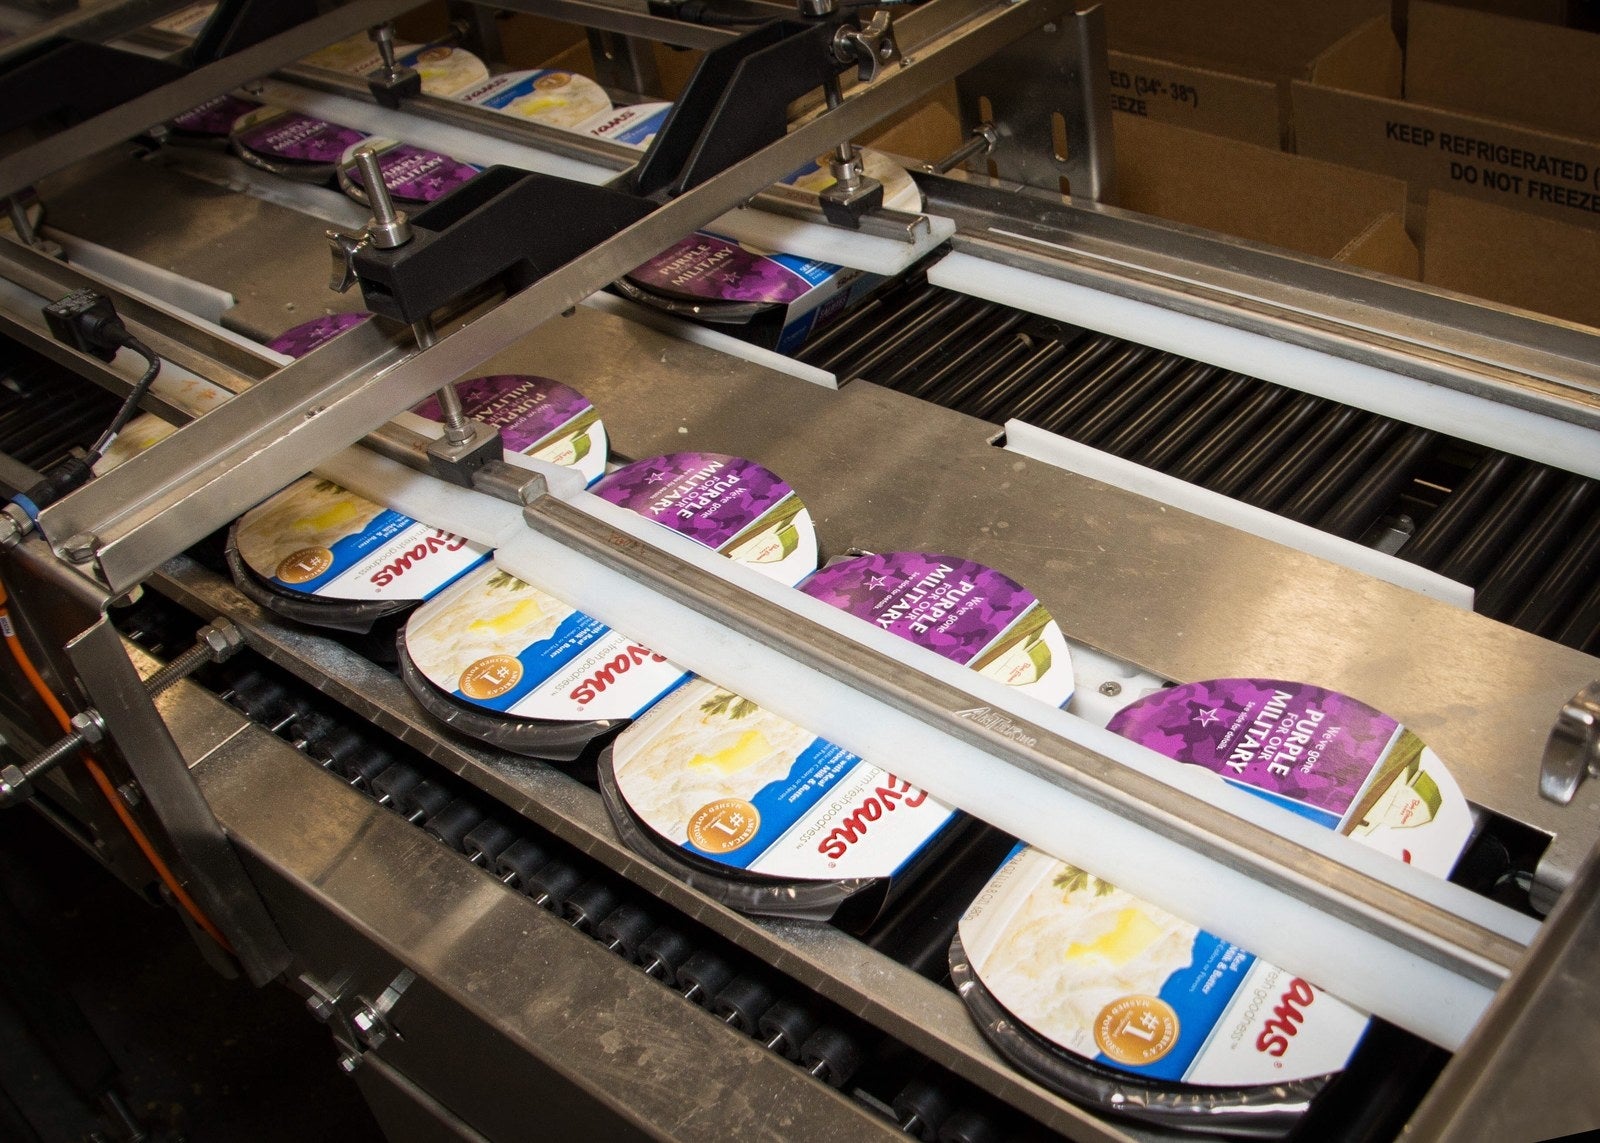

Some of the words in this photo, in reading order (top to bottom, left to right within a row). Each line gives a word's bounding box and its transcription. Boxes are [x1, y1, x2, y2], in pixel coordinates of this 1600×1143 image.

[1385, 121, 1435, 147] KEEP
[1439, 132, 1588, 183] REFRIGERATED
[385, 155, 444, 190] MILITARY
[1451, 161, 1478, 184] DO
[1482, 168, 1523, 195] NOT
[659, 243, 712, 276] PURPLE
[671, 246, 734, 286] MILITARY
[470, 380, 536, 422] MILITAR
[649, 460, 725, 515] MILITARY
[697, 475, 720, 491] FOR
[719, 487, 747, 504] We've
[675, 491, 699, 508] OUR
[676, 474, 740, 519] PURPLE
[700, 501, 722, 518] gone
[294, 556, 321, 572] #1
[876, 563, 954, 629] MILITARY
[927, 582, 952, 600] FOR
[904, 601, 930, 620] OUR
[908, 580, 975, 633] PURPLE
[956, 596, 984, 616] We've
[936, 614, 959, 633] gone
[480, 666, 510, 685] #1
[569, 643, 668, 705] vans
[1225, 689, 1293, 774] MILITARY
[1275, 712, 1299, 734] FOR
[1257, 736, 1282, 761] OUR
[1266, 708, 1326, 776] PURPLE
[1315, 726, 1341, 750] We've
[814, 764, 832, 780] Milk
[1300, 749, 1320, 774] gone
[806, 778, 817, 786] &
[817, 771, 836, 788] Real
[787, 784, 811, 804] Butter
[711, 811, 744, 836] #1
[721, 817, 755, 849] AMERICA'S
[799, 799, 843, 843] goodness
[1201, 969, 1224, 995] Butter
[1121, 1011, 1159, 1042] #1
[1230, 988, 1268, 1042] goodness
[1255, 976, 1317, 1058] ans
